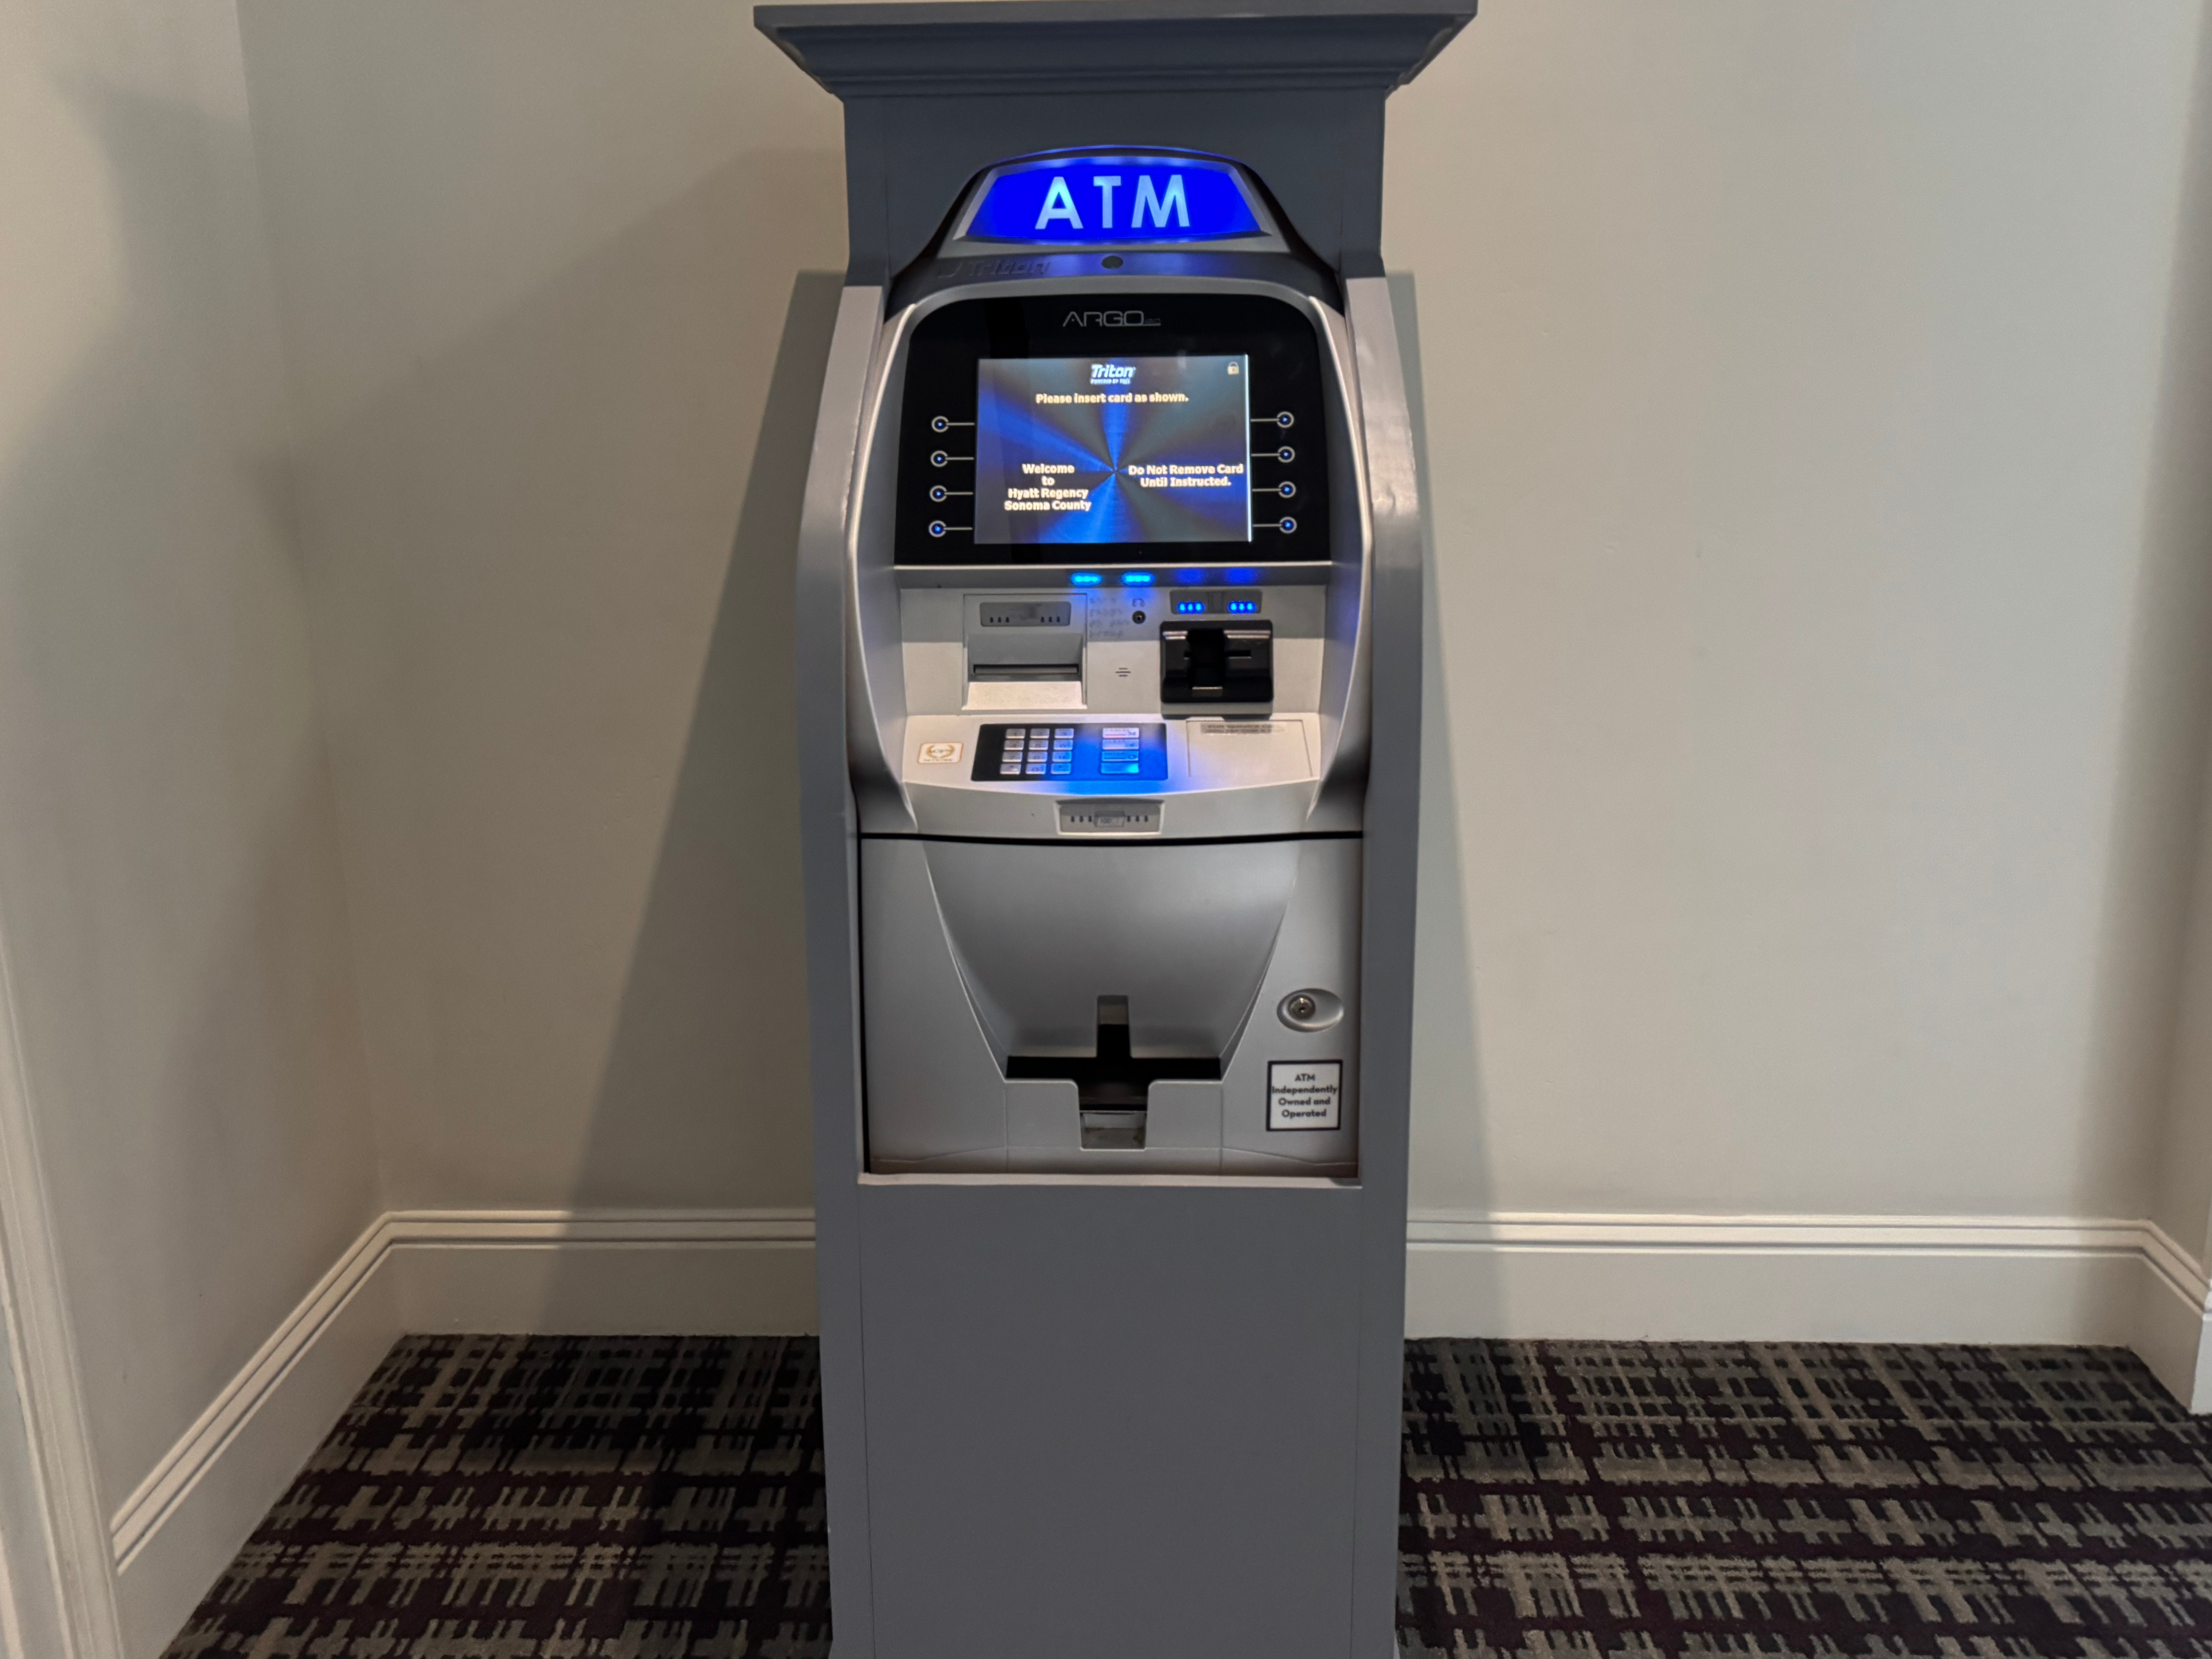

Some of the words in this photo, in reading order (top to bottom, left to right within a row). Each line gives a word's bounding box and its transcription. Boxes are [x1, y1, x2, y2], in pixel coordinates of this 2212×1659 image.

[1035, 174, 1190, 230] ATM
[1063, 310, 1144, 327] ARGO
[1091, 364, 1134, 378] Triton
[1036, 393, 1072, 404] Please
[1074, 393, 1106, 403] insert
[1108, 392, 1132, 403] card
[1135, 394, 1147, 403] as
[1149, 392, 1189, 402] shown.
[1022, 463, 1075, 474] Welcome
[1128, 465, 1144, 476] Do
[1146, 465, 1168, 475] Not
[1169, 465, 1216, 475] Remove
[1217, 464, 1243, 474] Card
[1041, 476, 1055, 486] to
[1140, 477, 1168, 487] Until
[1170, 476, 1232, 487] Instructed.
[1008, 488, 1040, 500] Hyatt
[1041, 488, 1089, 500] Regency
[1004, 500, 1050, 510] Sonoma
[1051, 500, 1092, 512] County
[1295, 1073, 1316, 1082] ATM
[1271, 1084, 1337, 1096] Independently
[1278, 1097, 1311, 1106] Owned
[1313, 1097, 1331, 1105] and
[1281, 1108, 1327, 1120] Operated
